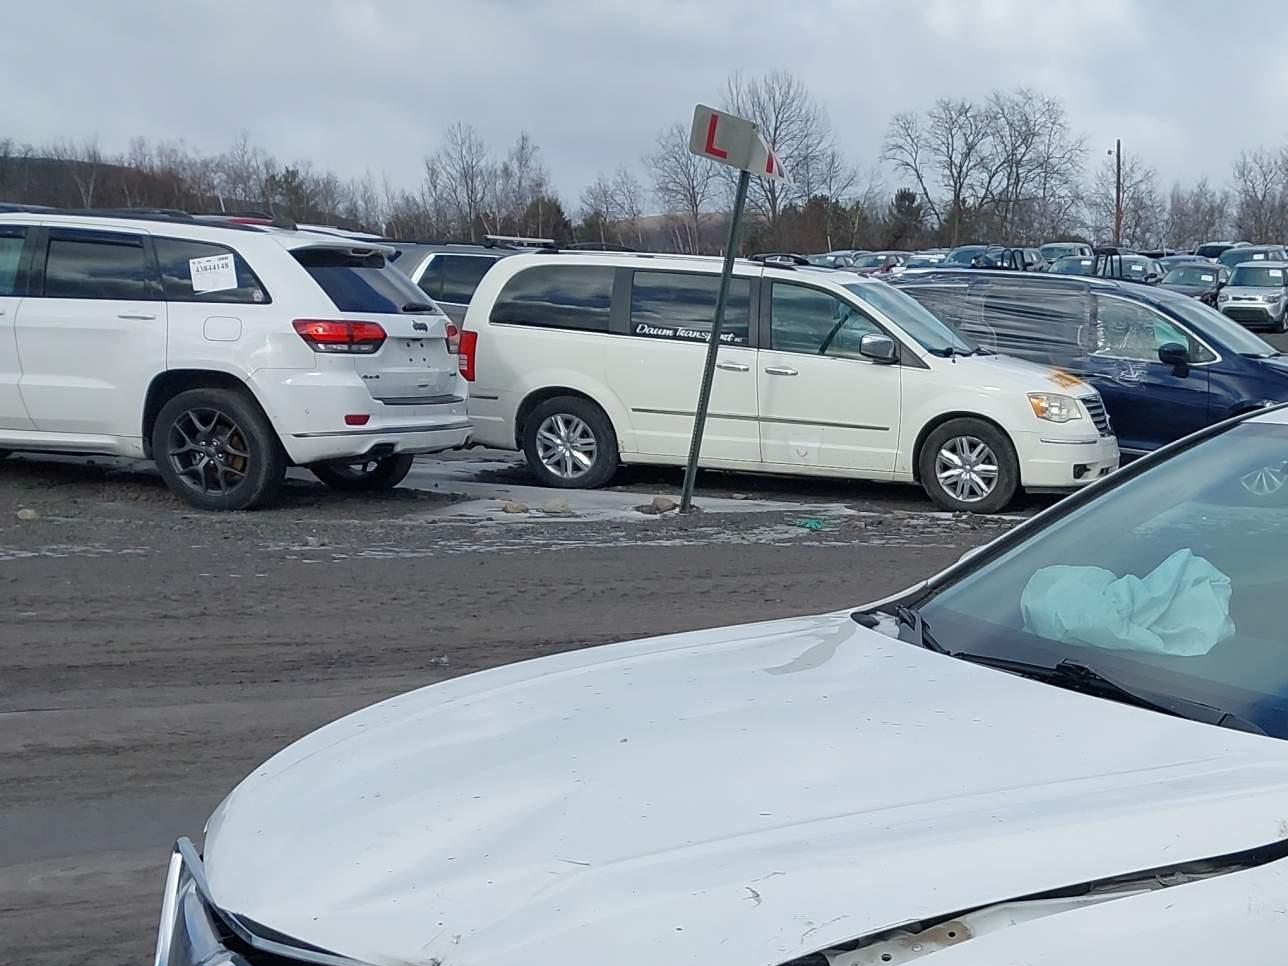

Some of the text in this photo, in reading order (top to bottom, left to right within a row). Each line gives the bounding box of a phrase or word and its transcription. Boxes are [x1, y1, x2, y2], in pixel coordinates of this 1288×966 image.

[705, 114, 727, 159] L
[636, 324, 674, 336] Daum
[674, 326, 734, 342] Transprt
